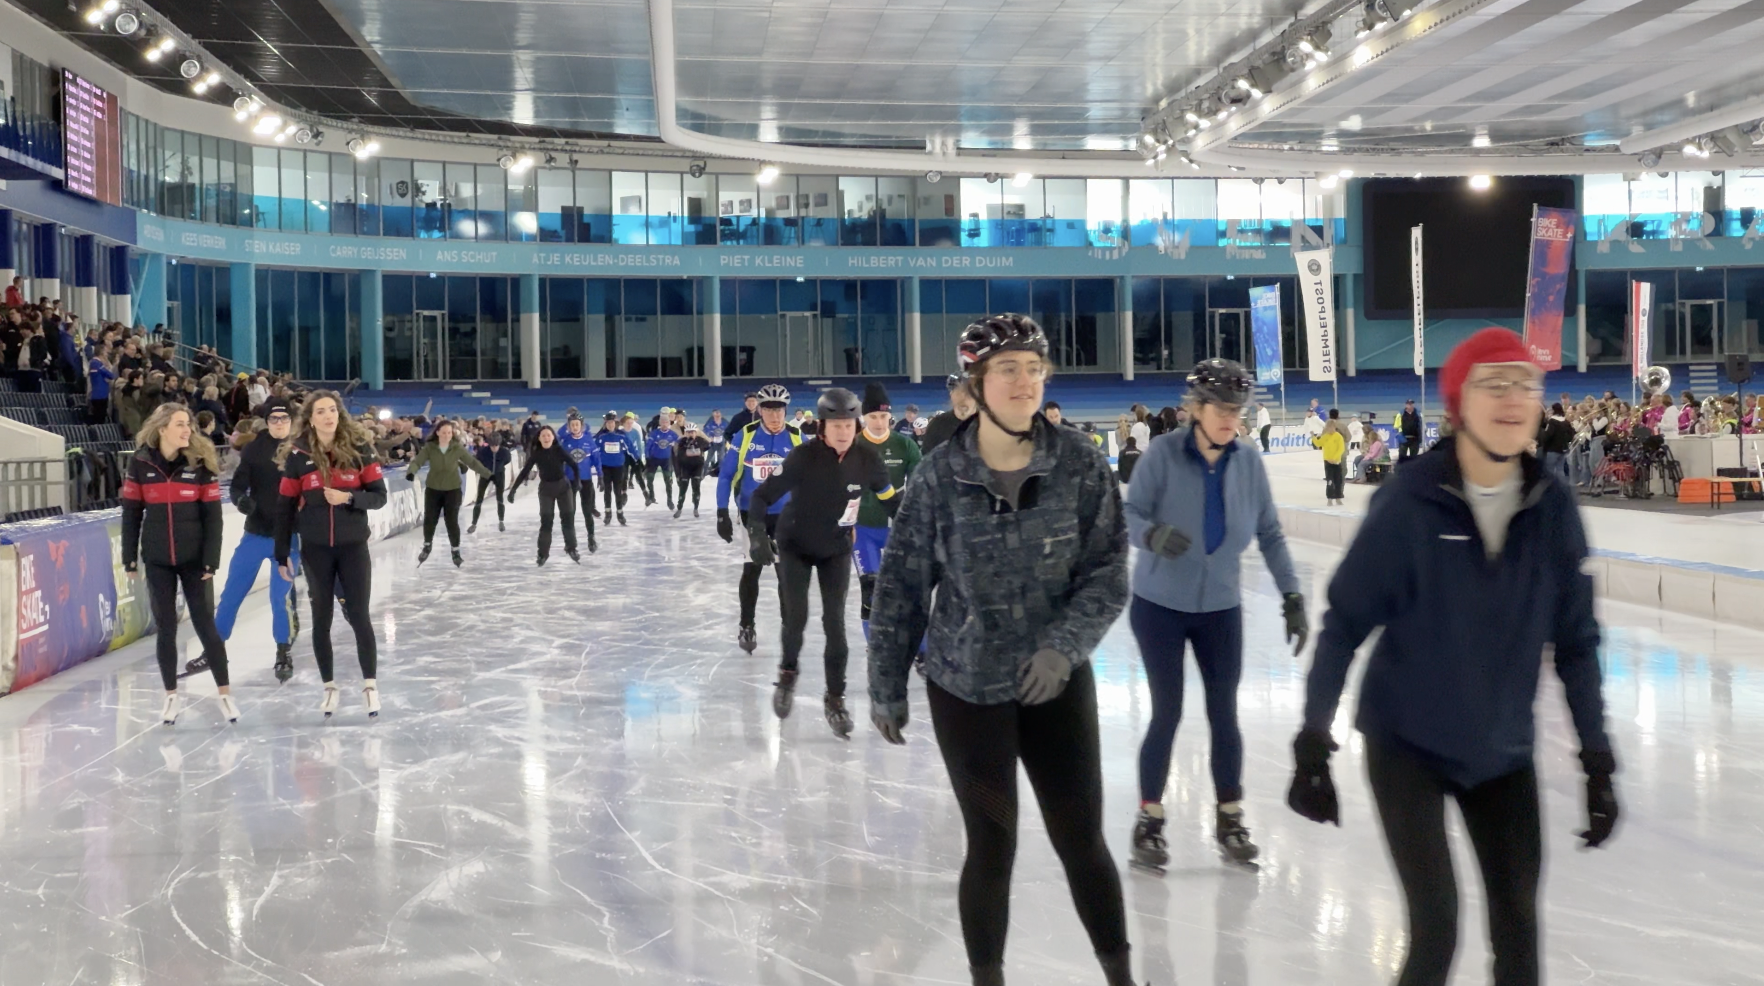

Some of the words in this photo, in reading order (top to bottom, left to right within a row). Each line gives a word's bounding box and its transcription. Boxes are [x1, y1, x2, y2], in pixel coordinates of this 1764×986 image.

[1538, 218, 1557, 228] BIKE
[1536, 227, 1564, 239] SKATE
[268, 242, 300, 254] KAISER
[329, 245, 358, 258] CARRY
[436, 250, 458, 262] ANS
[461, 251, 497, 263] SCHUT
[532, 254, 561, 265] ATJE
[565, 254, 681, 267] KEULEN-DEELSTRA
[720, 255, 750, 267] PIET
[755, 255, 805, 267] KLEINE
[848, 256, 903, 268] HILBERT
[907, 256, 937, 268] VAN
[941, 256, 971, 268] DER
[975, 256, 1013, 268] DUIM
